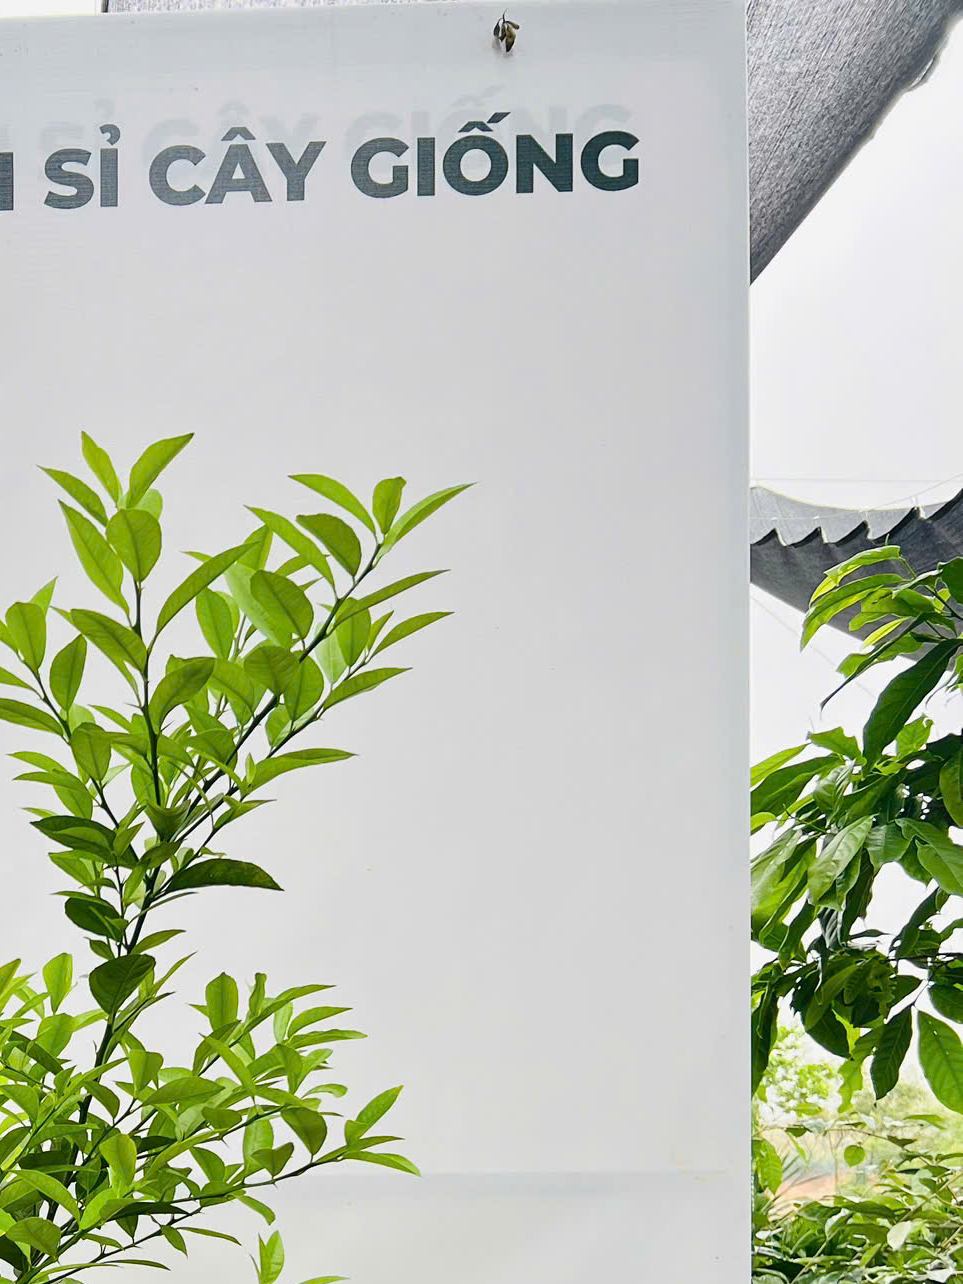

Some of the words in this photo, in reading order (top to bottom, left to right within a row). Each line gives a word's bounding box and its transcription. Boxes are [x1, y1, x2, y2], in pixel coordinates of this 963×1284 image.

[43, 124, 121, 210] SỈ
[146, 127, 327, 206] CÂY
[350, 111, 640, 199] GIỐNG
